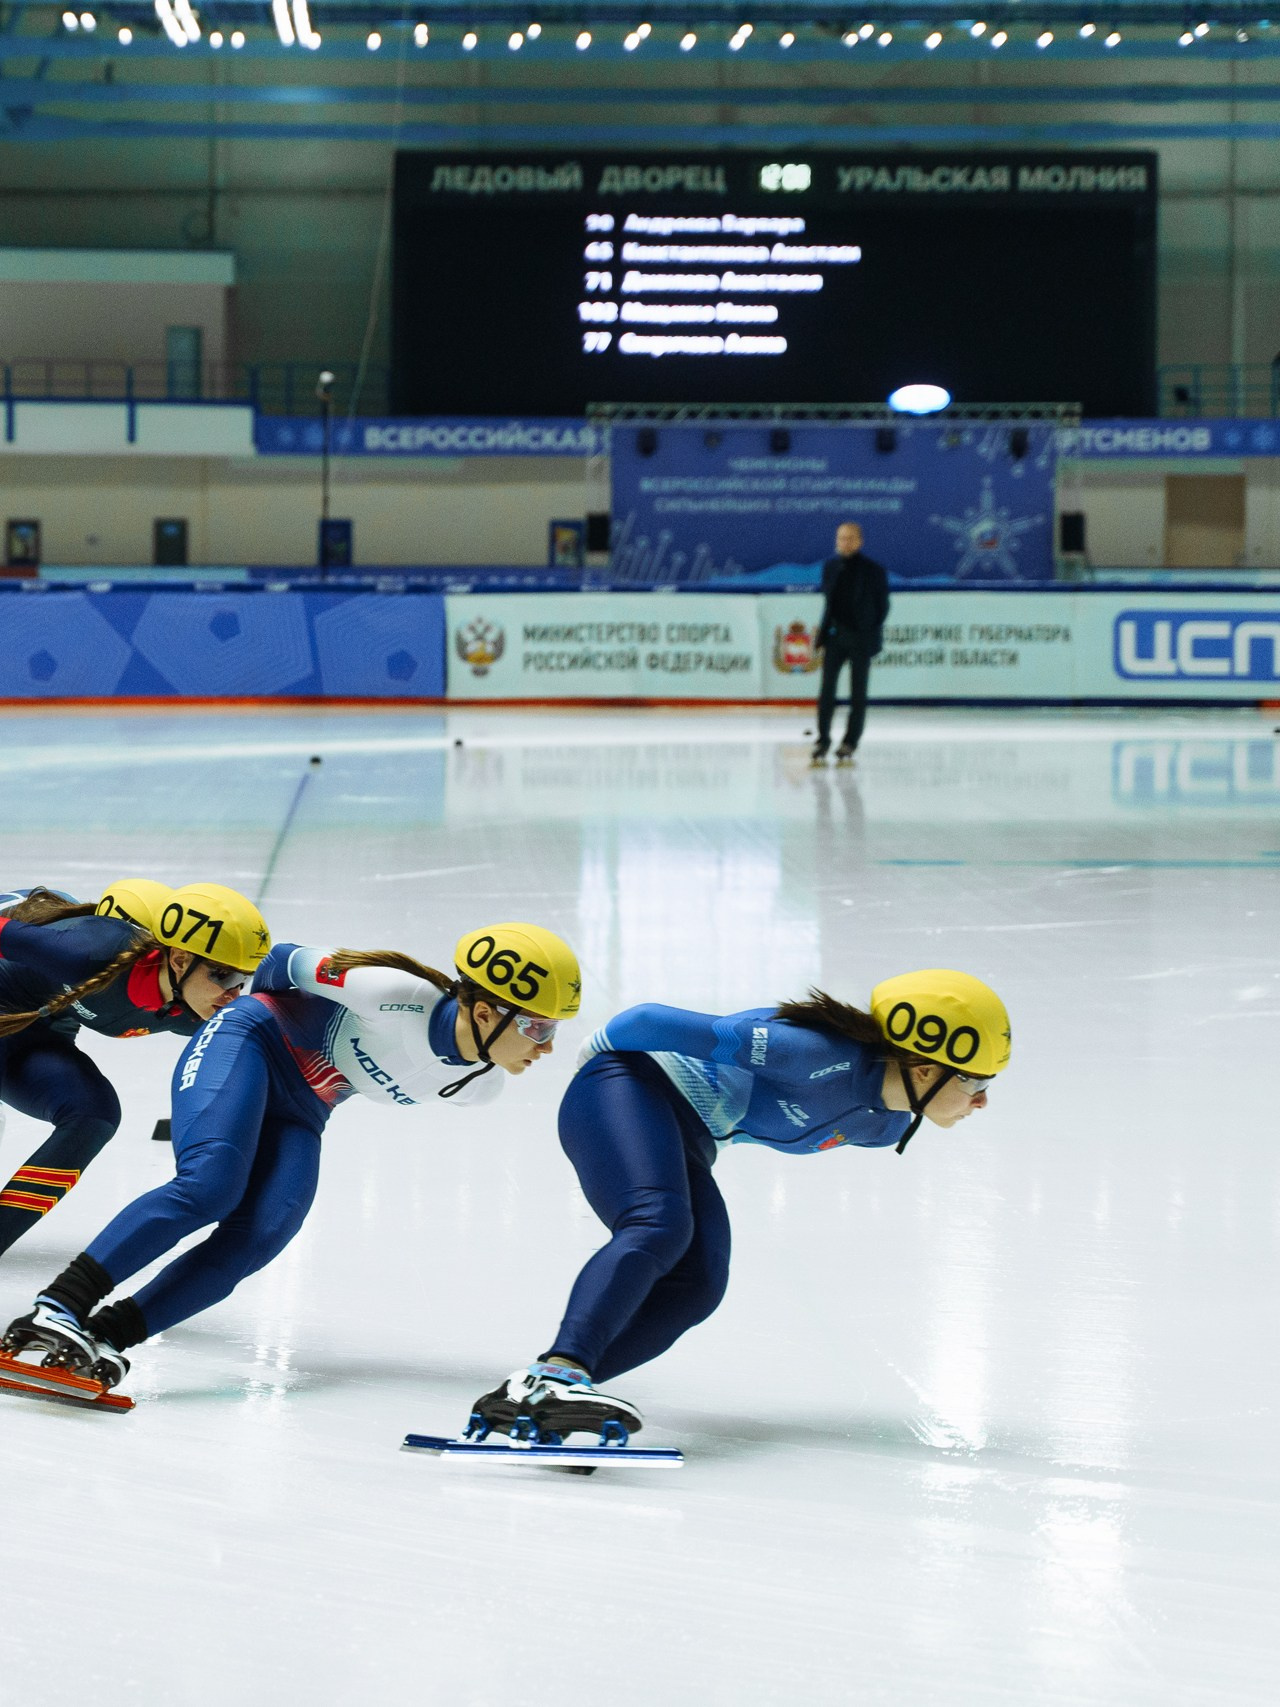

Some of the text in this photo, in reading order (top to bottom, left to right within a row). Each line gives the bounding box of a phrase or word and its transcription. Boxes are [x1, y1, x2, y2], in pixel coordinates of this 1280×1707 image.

[431, 162, 582, 192] ЛЕДОВЫЙ
[598, 165, 727, 193] ДВОРЕЦ
[837, 166, 1010, 191] УРАЛЬСКАЯ
[1019, 166, 1147, 191] МОЛНИЯ
[364, 421, 595, 449] ВСЕРОССИЙСКАЯ
[523, 622, 733, 644] МИНИСТЕРСТВО СПОРТА
[883, 624, 1072, 644] ОДДЕРЖКЕ ГУБЕРНАТОРА
[522, 647, 752, 675] РОССИЙСКОЙ ФЕДЕРАЦИИ
[951, 648, 1019, 668] ОБЛАСТИ
[1120, 620, 1280, 676] ЦСП
[160, 902, 224, 955] 071
[466, 936, 550, 1002] 065
[379, 1003, 425, 1014] corsa
[886, 1001, 981, 1065] 090
[178, 1007, 237, 1093] МОСКВА
[349, 1037, 423, 1106] МОСКВ
